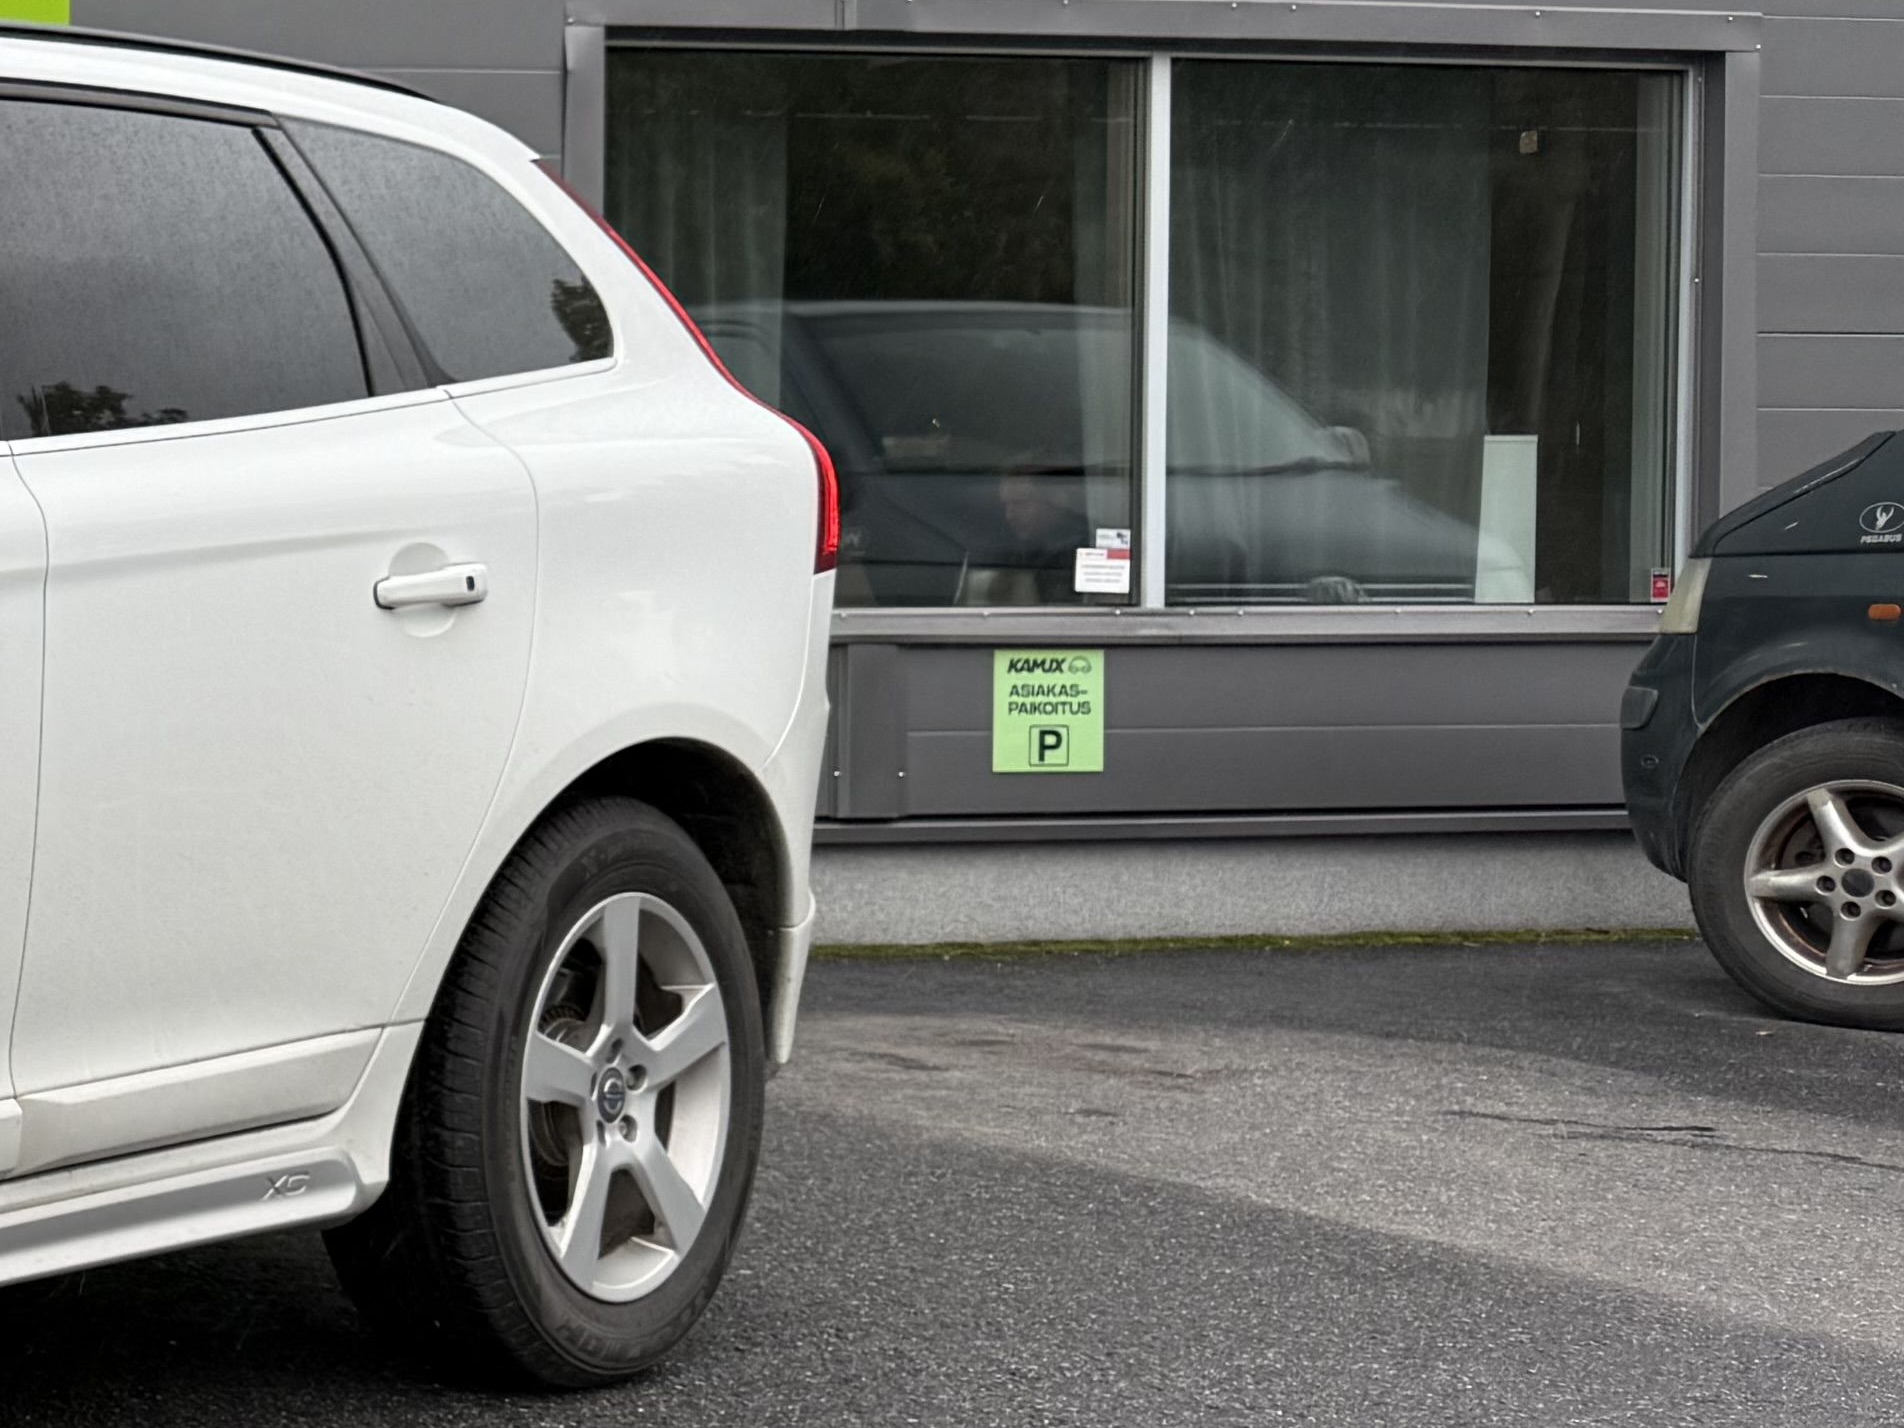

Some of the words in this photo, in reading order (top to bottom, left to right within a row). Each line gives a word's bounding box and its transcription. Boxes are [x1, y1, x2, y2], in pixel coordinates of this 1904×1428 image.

[1007, 657, 1067, 674] KAMUX
[1008, 683, 1088, 699] ASIAKAS-
[1008, 700, 1092, 716] PAIKOITUS
[1038, 729, 1063, 762] P
